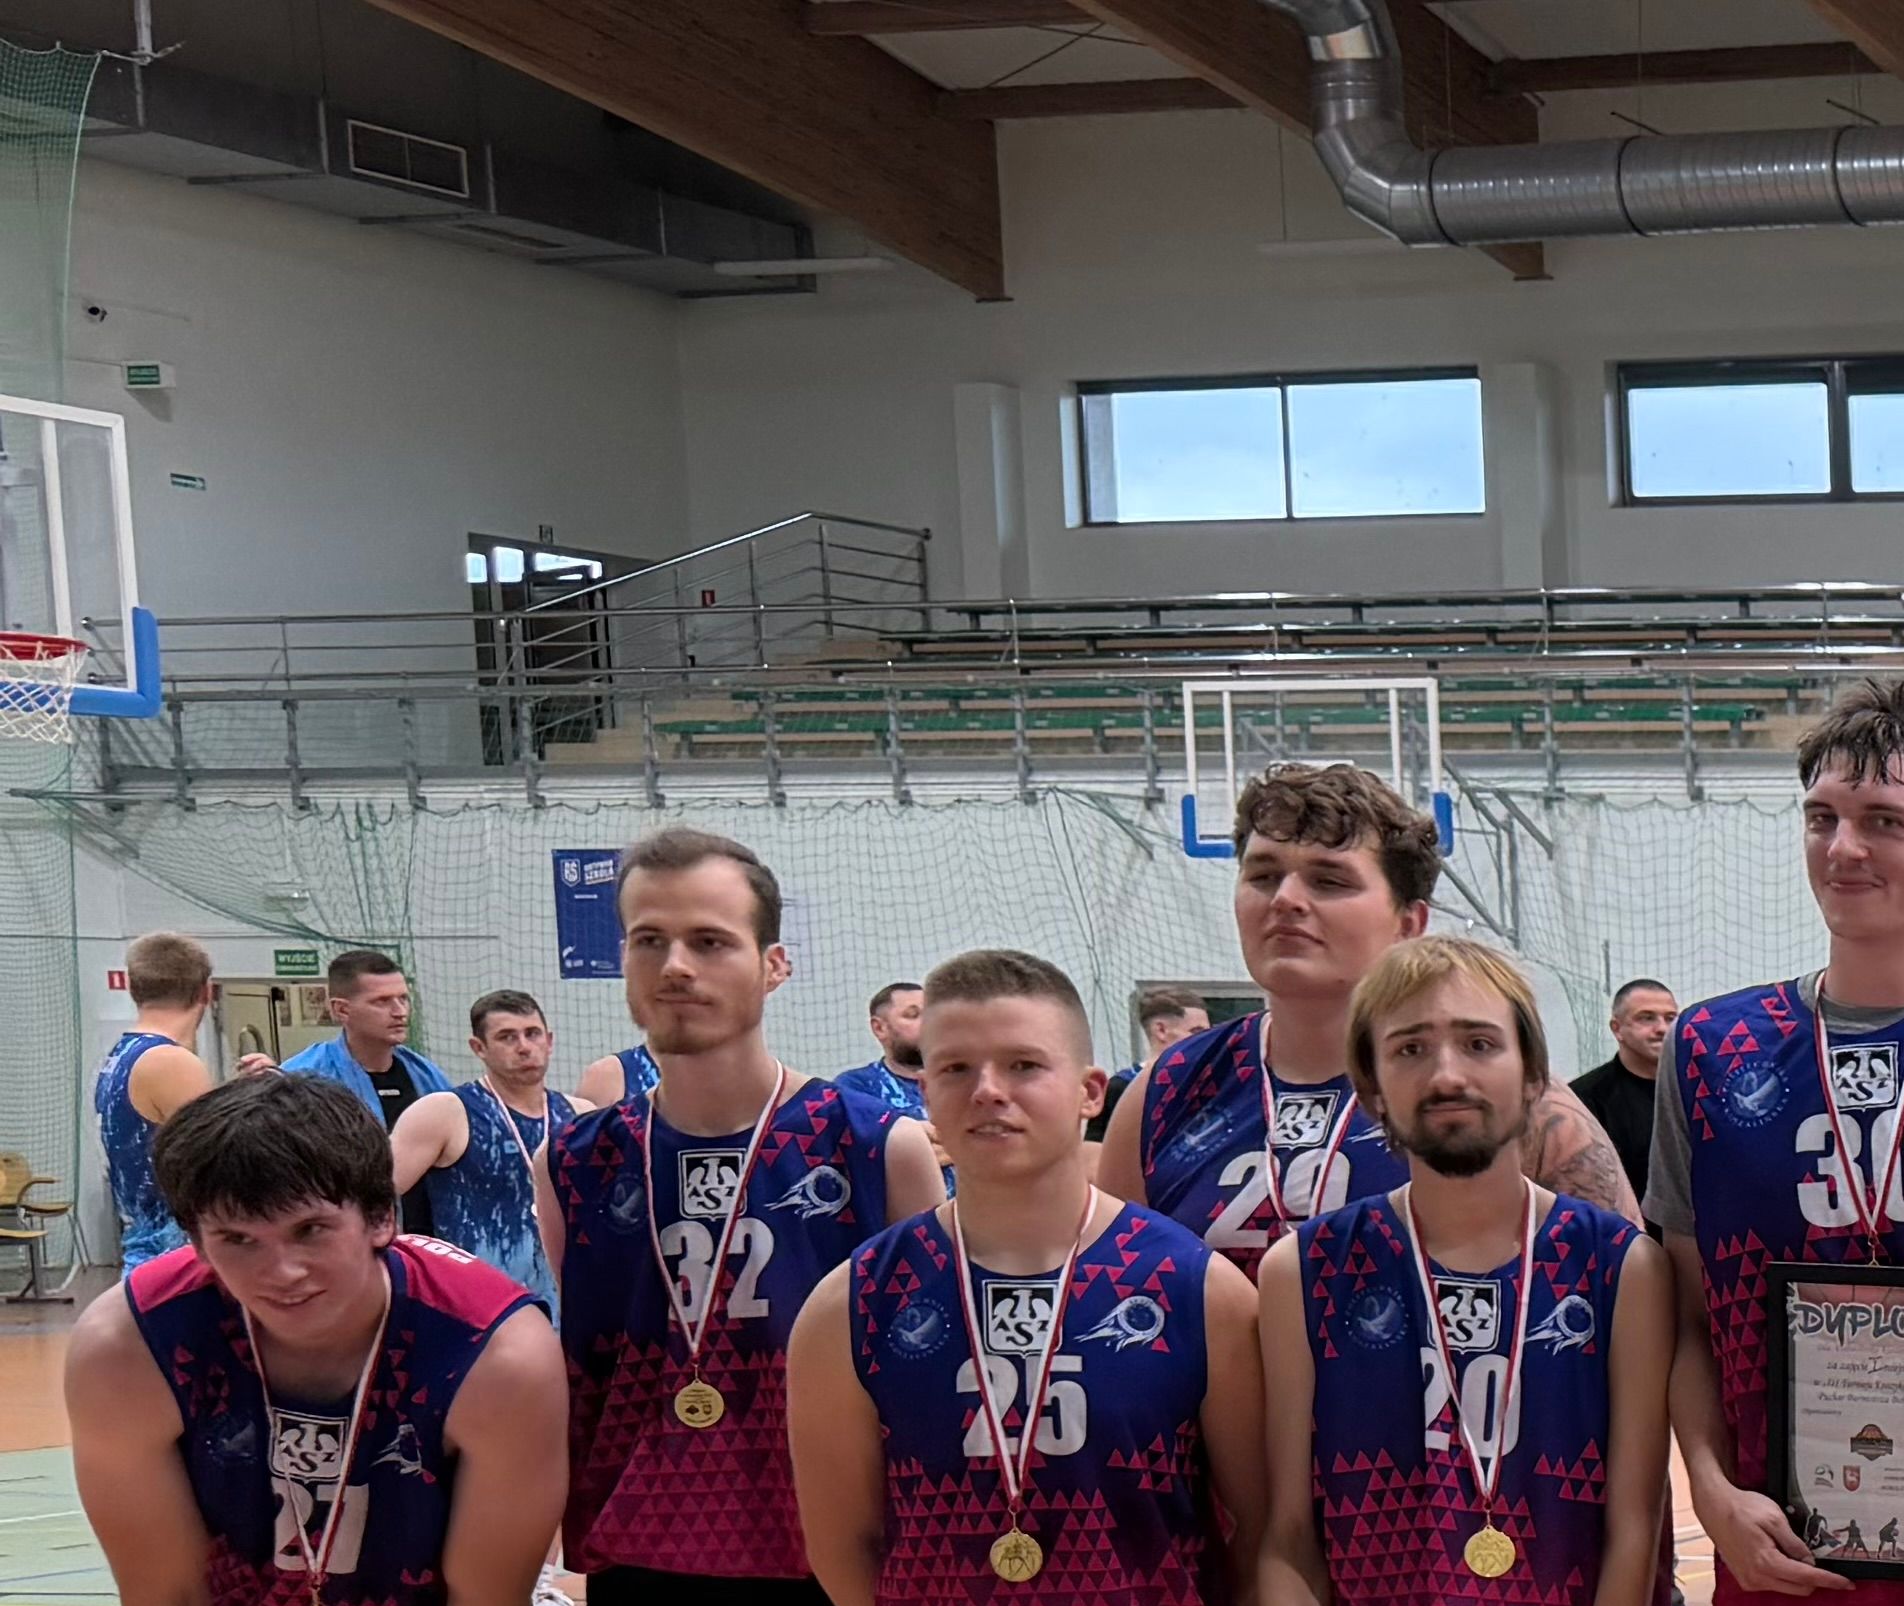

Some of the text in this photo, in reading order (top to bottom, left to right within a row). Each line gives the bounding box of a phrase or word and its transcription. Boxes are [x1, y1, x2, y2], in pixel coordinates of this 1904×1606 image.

[658, 1219, 775, 1321] 32
[956, 1354, 1087, 1457] 25
[1420, 1346, 1521, 1457] 20
